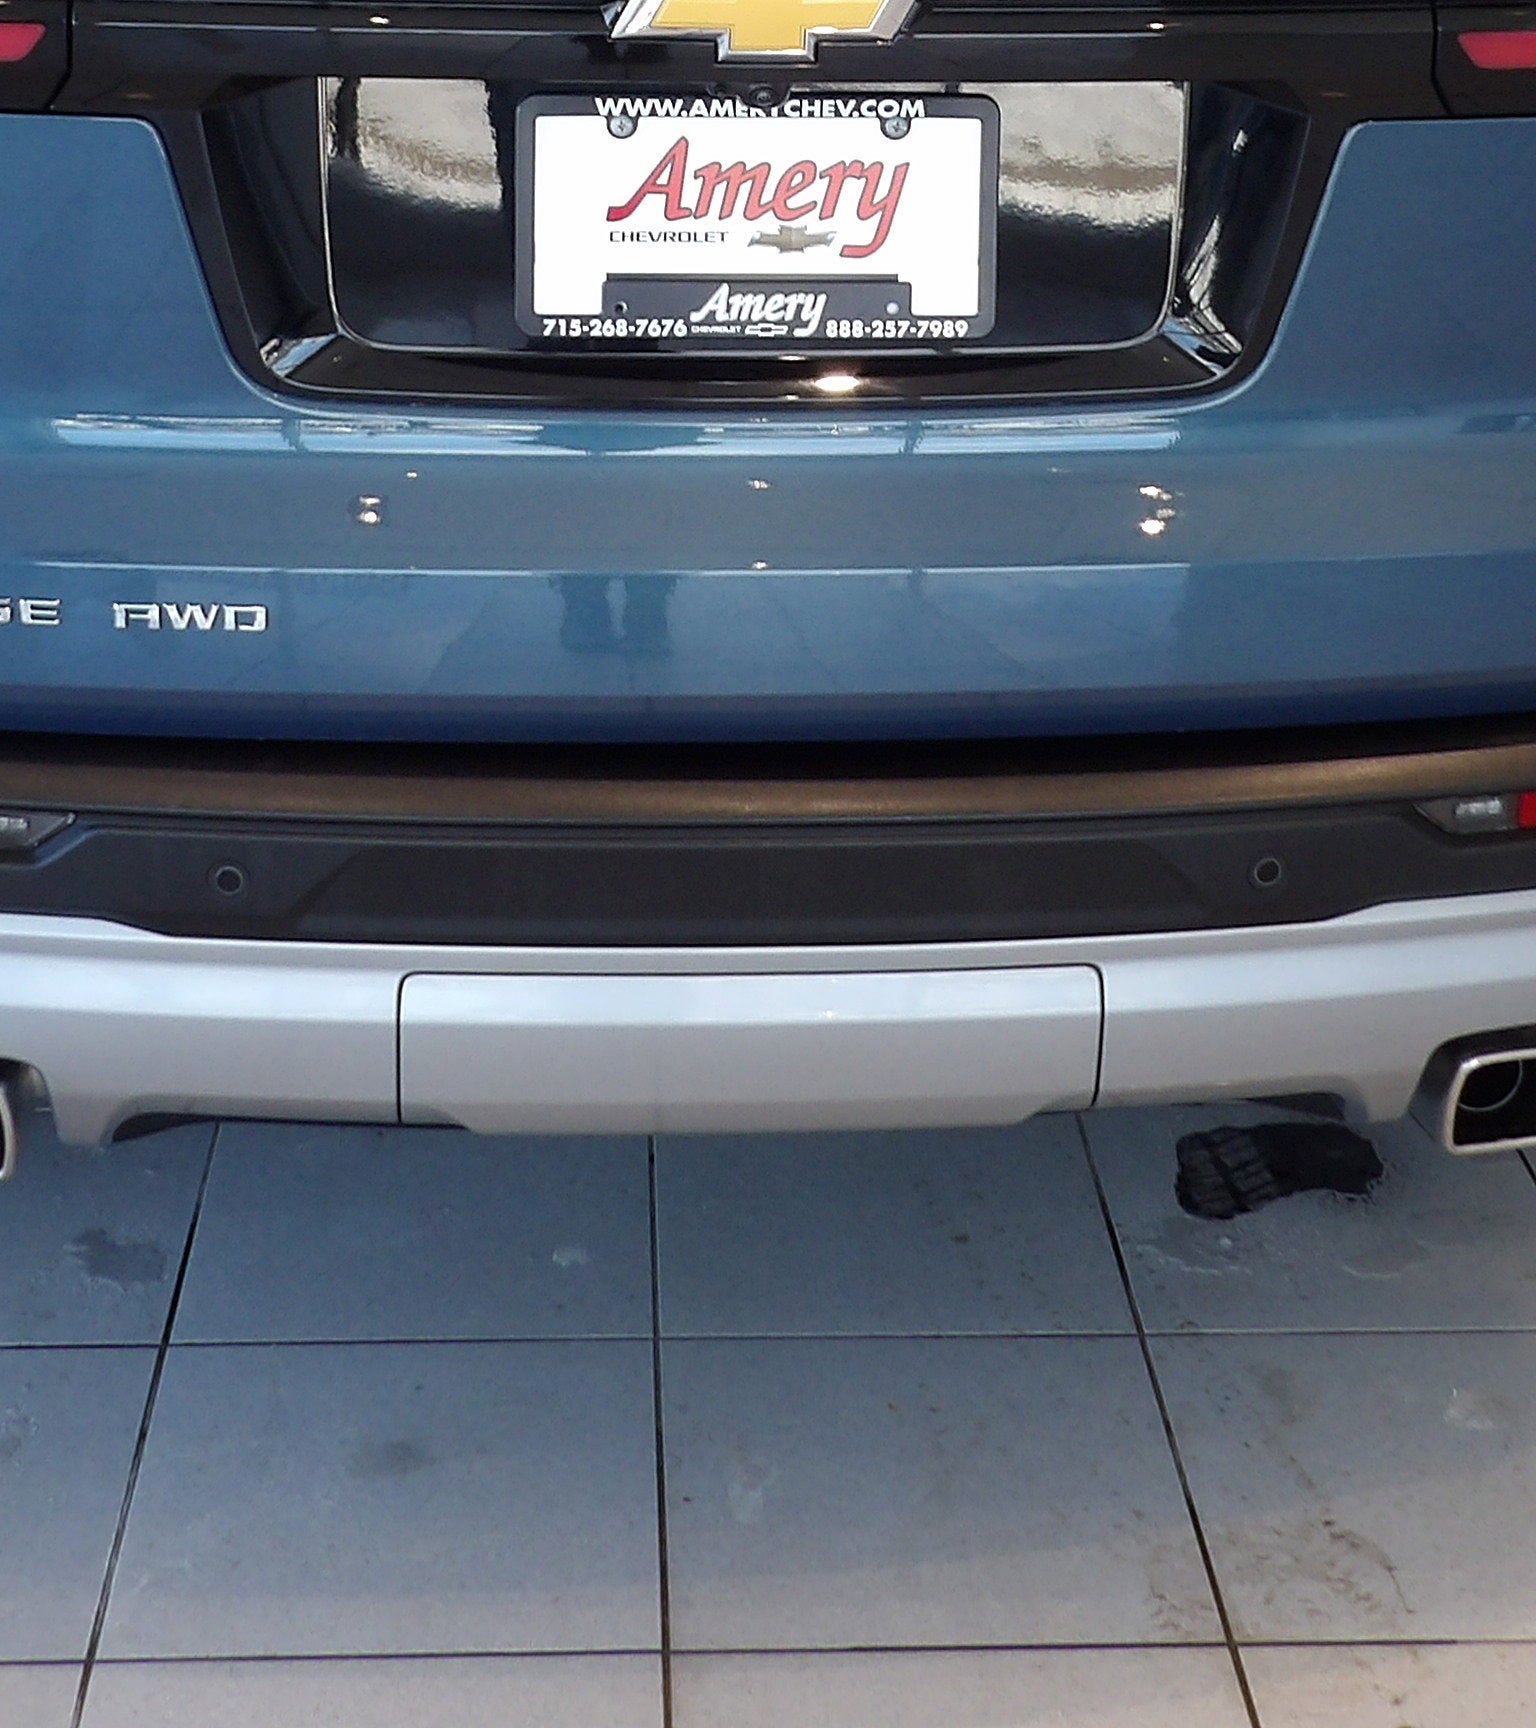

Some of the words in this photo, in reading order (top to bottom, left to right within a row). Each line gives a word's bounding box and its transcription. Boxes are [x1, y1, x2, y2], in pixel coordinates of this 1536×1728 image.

[605, 135, 910, 259] Amery
[608, 229, 730, 244] CHEVROLET
[689, 282, 828, 338] Amery
[542, 318, 688, 338] 715-268-7676
[825, 319, 969, 339] 888-257-7989
[112, 600, 269, 633] AWD
